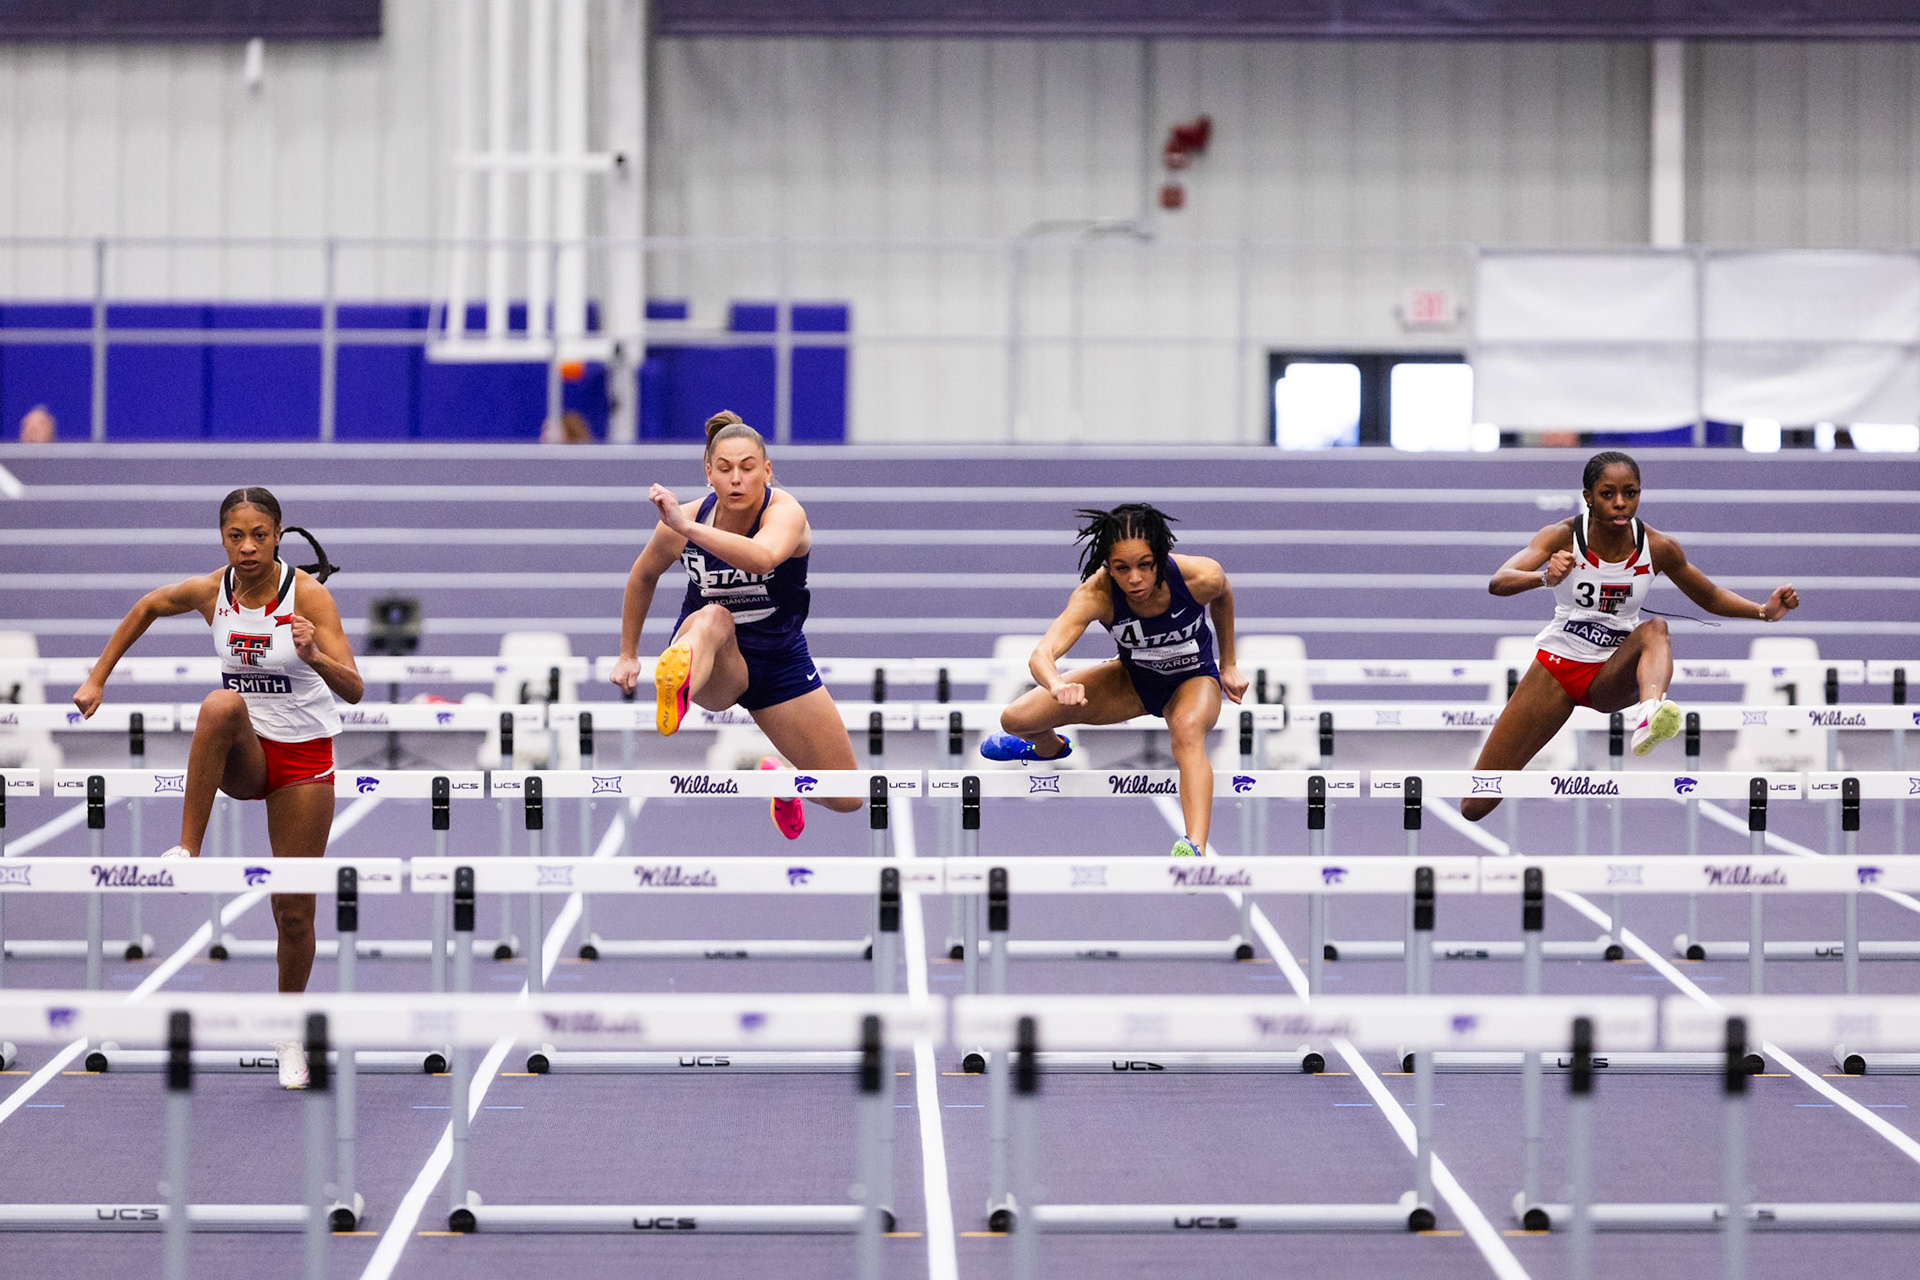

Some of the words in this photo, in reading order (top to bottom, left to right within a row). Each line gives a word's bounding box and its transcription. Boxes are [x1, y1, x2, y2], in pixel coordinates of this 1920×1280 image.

[687, 556, 702, 584] 5
[1575, 582, 1595, 608] 3
[1121, 625, 1140, 646] 4
[1565, 623, 1626, 646] HARRIS
[228, 678, 286, 692] SMITH
[1809, 711, 1867, 726] Wildcats
[670, 775, 739, 794] Wildcats
[1108, 775, 1178, 794] Wildcats
[1550, 776, 1619, 795] Wildcats
[91, 865, 174, 886] Wildcats
[635, 866, 717, 886] Wildcats
[1169, 866, 1251, 886] Wildcats
[1704, 866, 1787, 885] Wildcats
[1816, 947, 1843, 957] UC
[680, 1056, 730, 1066] UCS
[1558, 1057, 1608, 1068] US
[97, 1208, 158, 1220] UCS
[633, 1217, 697, 1229] UCS
[1174, 1217, 1238, 1229] UCS
